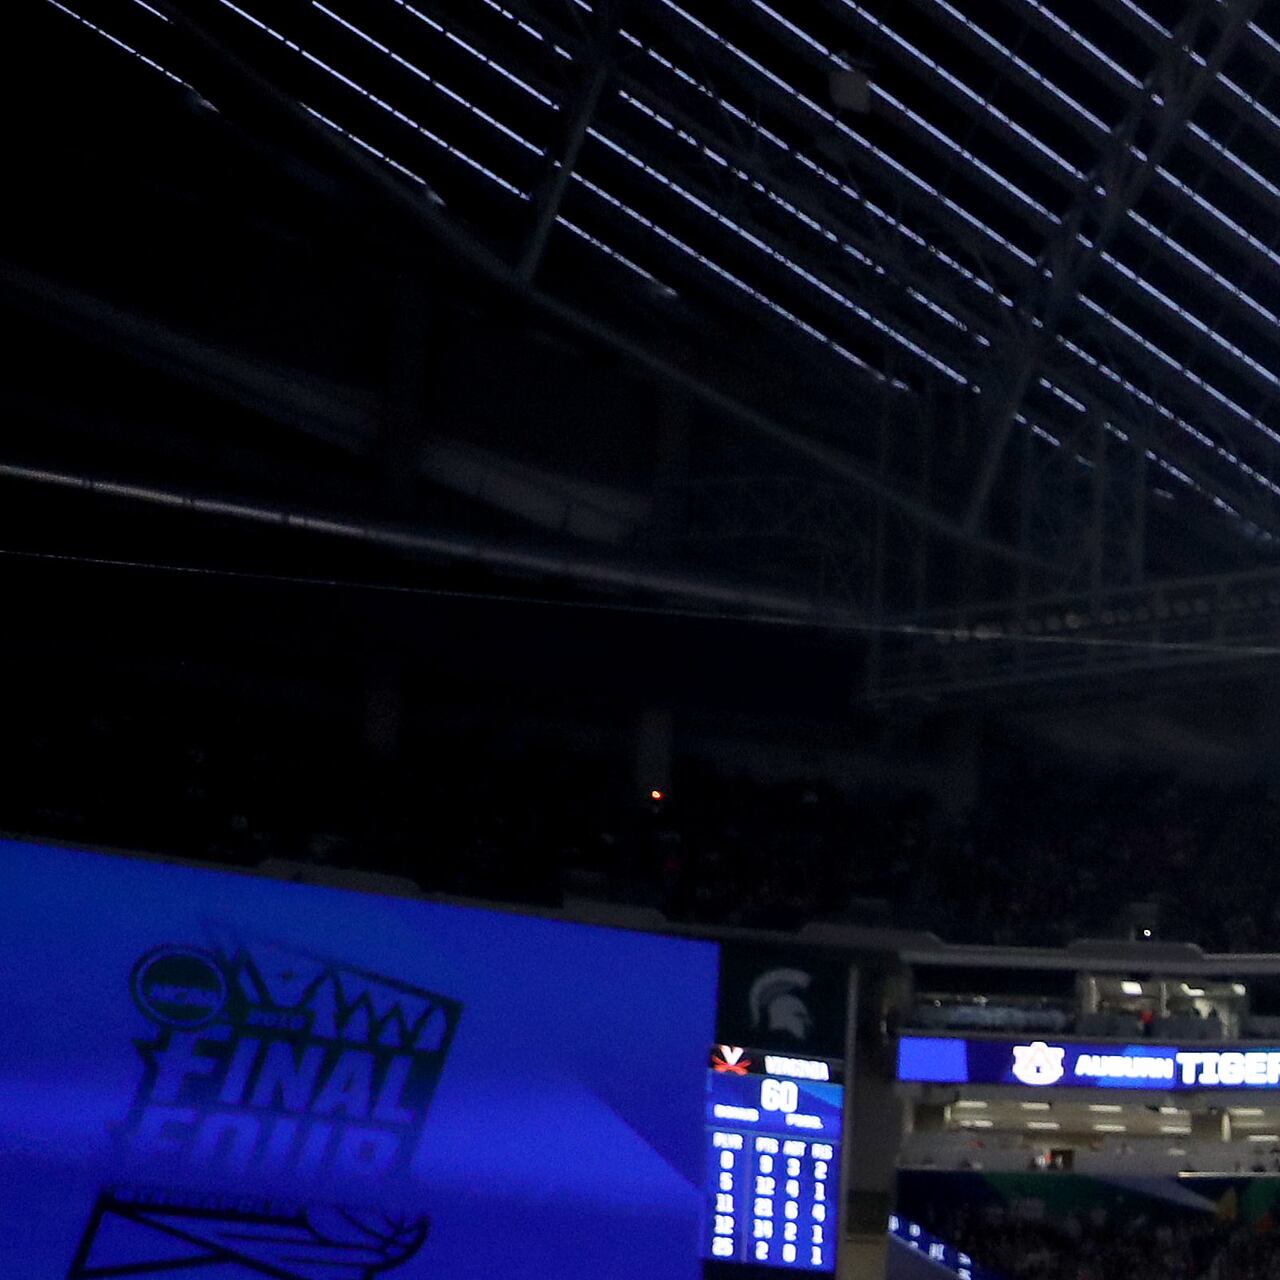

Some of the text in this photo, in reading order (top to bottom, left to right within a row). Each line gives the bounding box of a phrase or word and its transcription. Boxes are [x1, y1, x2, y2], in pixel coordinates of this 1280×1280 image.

[149, 1026, 416, 1122] FINAL
[1074, 1054, 1174, 1080] AUBURN
[760, 1078, 799, 1114] 60
[787, 1157, 801, 1177] 3
[814, 1160, 828, 1180] 2
[814, 1181, 826, 1201] 1
[784, 1221, 798, 1242] 2
[812, 1224, 824, 1244] 1
[755, 1240, 769, 1260] 2
[810, 1245, 823, 1265] 1
